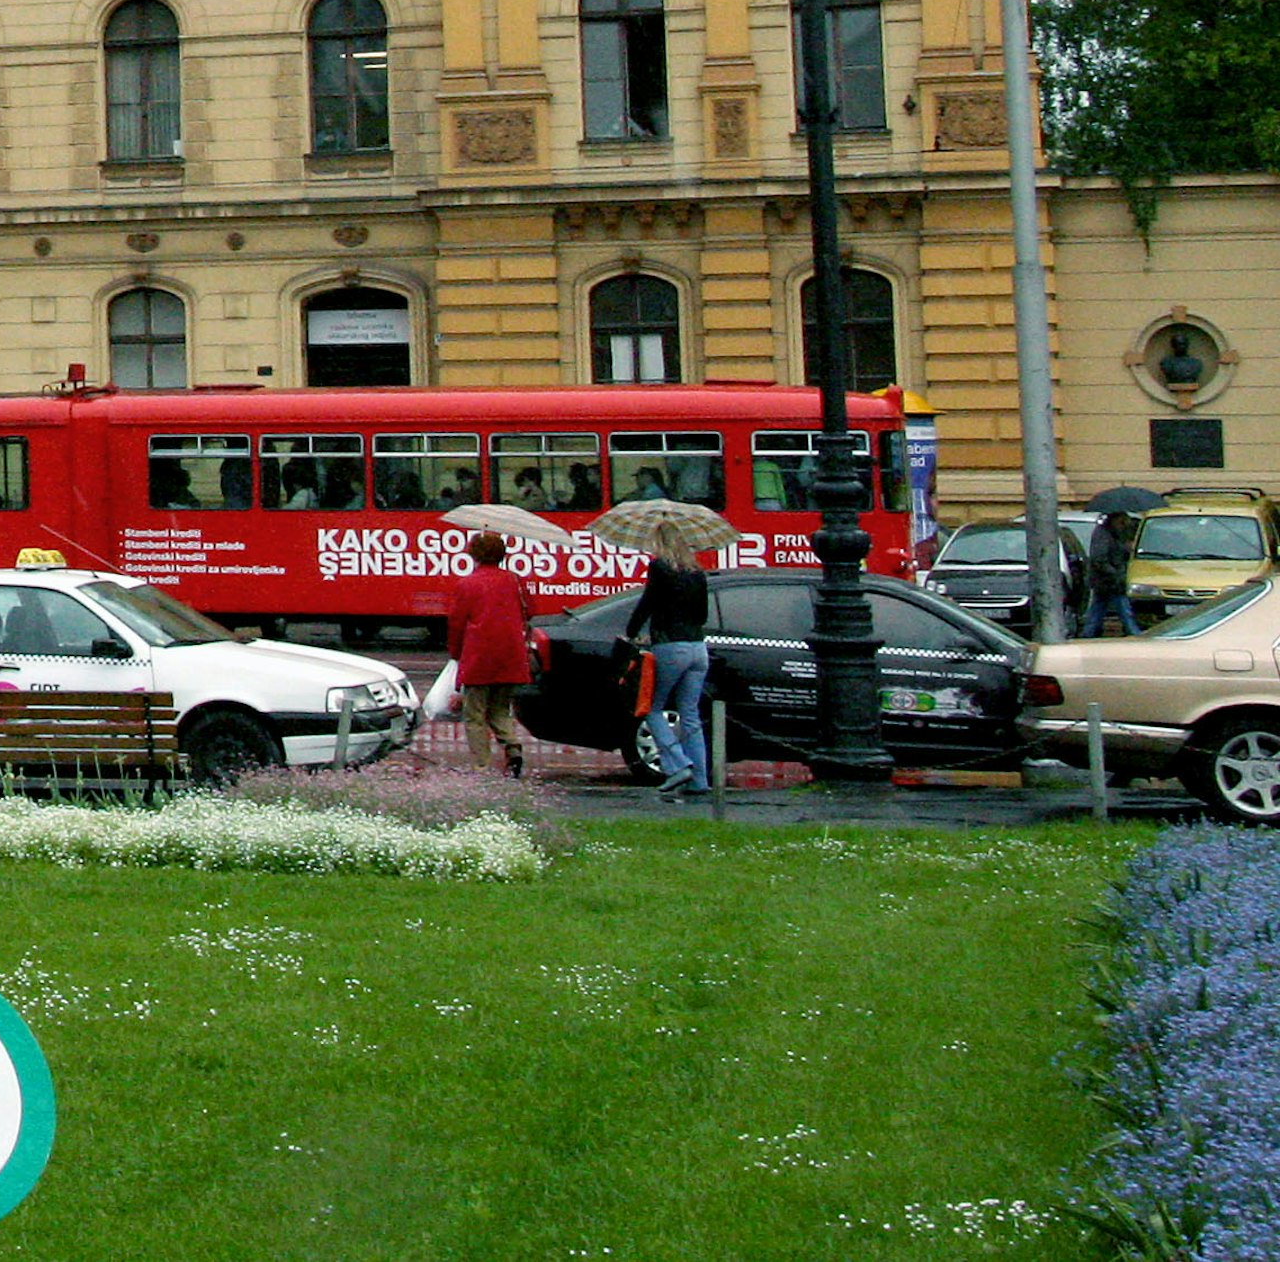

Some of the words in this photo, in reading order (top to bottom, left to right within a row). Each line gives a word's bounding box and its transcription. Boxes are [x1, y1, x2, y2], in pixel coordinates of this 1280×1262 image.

[170, 528, 202, 538] krediti
[170, 540, 202, 550] krediti
[317, 528, 408, 553] KAKO
[175, 552, 207, 562] krediti
[175, 564, 207, 574] krediti
[208, 566, 220, 574] za
[318, 552, 475, 581] OKRENEŠ
[498, 553, 558, 578] GO
[148, 575, 180, 585] krediti
[538, 581, 591, 596] krediti
[592, 584, 610, 596] su
